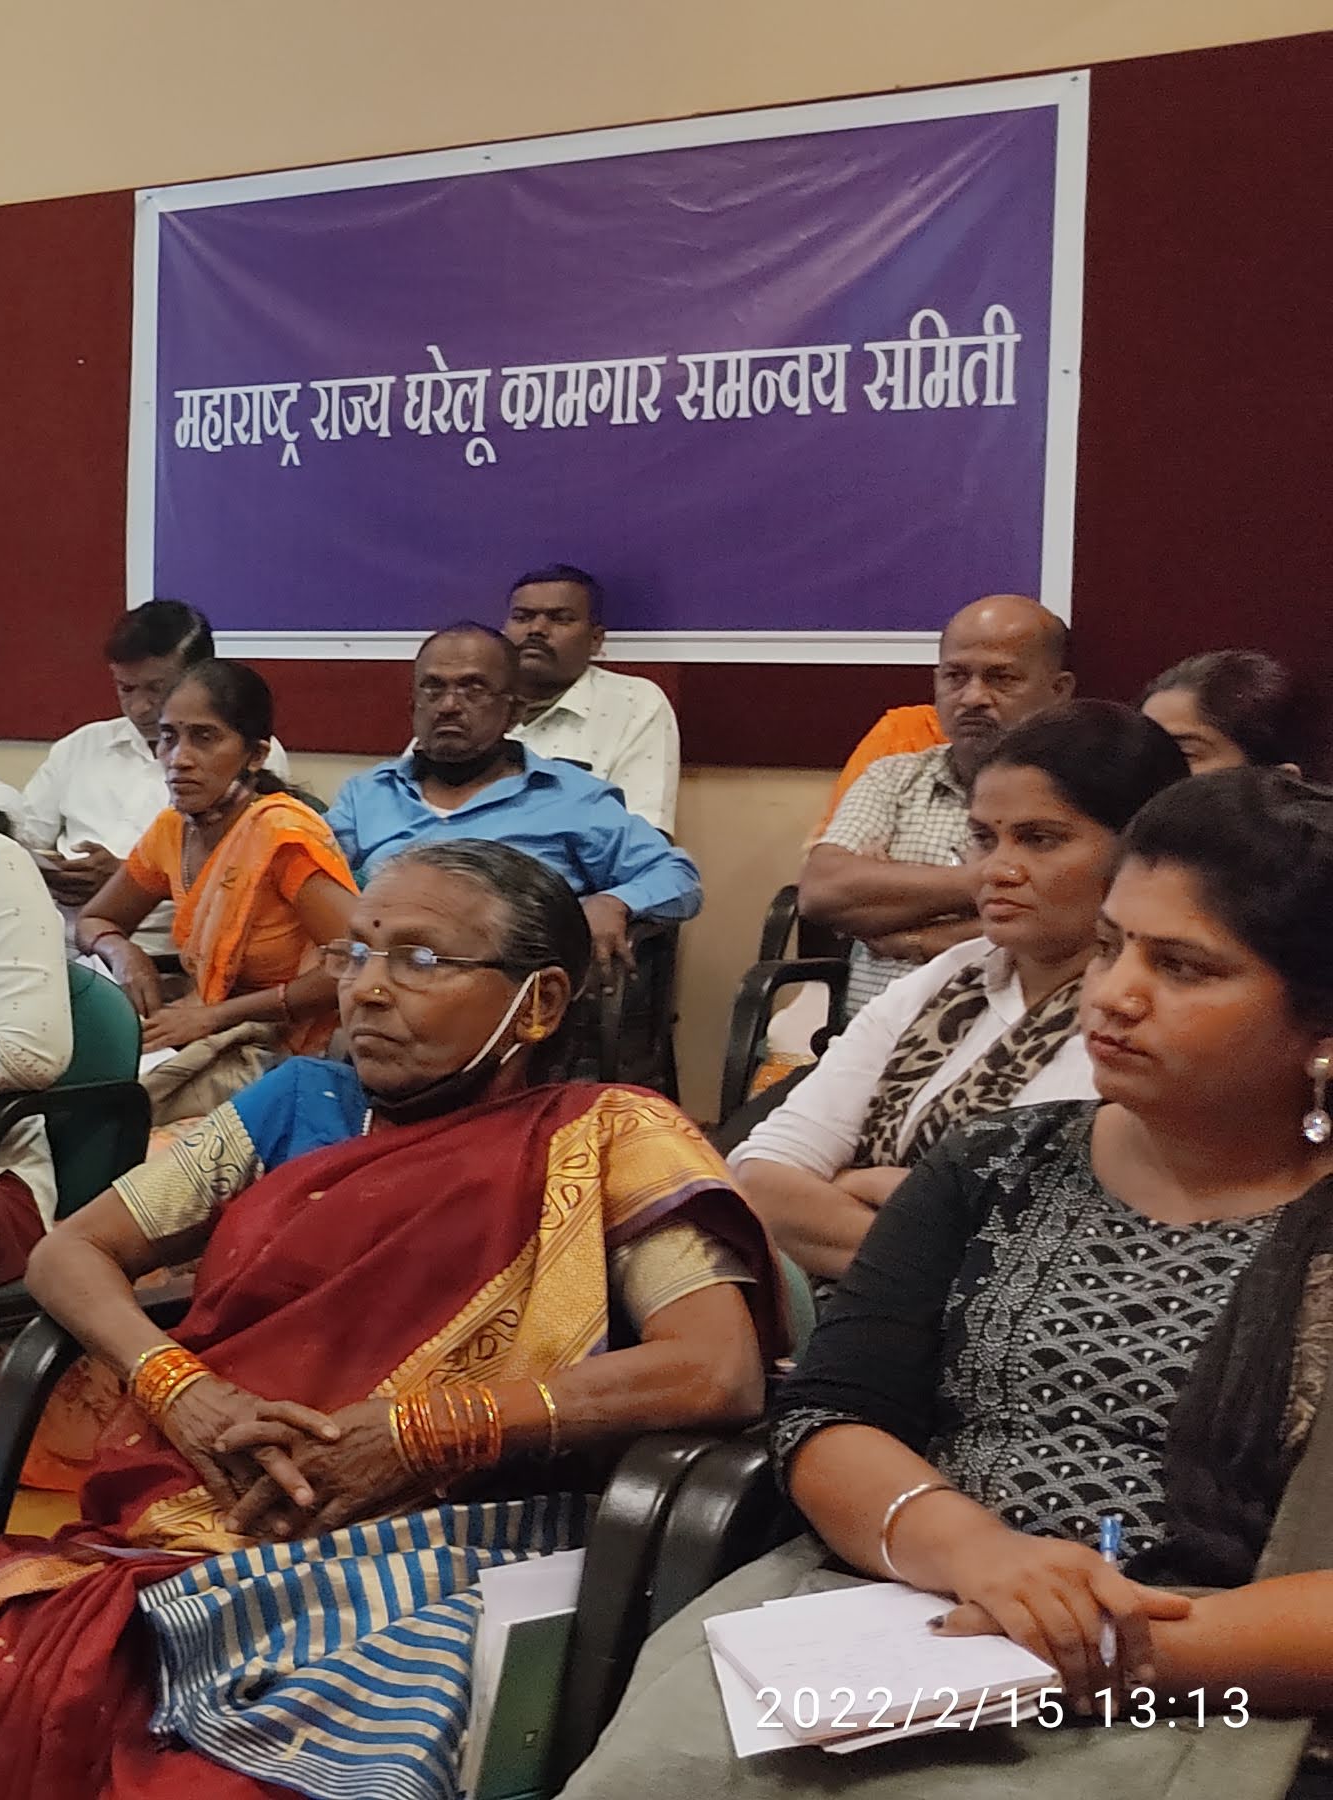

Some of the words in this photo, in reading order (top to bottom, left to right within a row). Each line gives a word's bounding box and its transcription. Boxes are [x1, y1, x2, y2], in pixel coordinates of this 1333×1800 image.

[174, 382, 302, 467] महाराष्ट्र
[309, 375, 397, 441] राज्य
[403, 345, 496, 466] घरेलू
[500, 355, 667, 430] कामगार
[675, 343, 852, 421] समन्वय
[863, 304, 1022, 411] समिती
